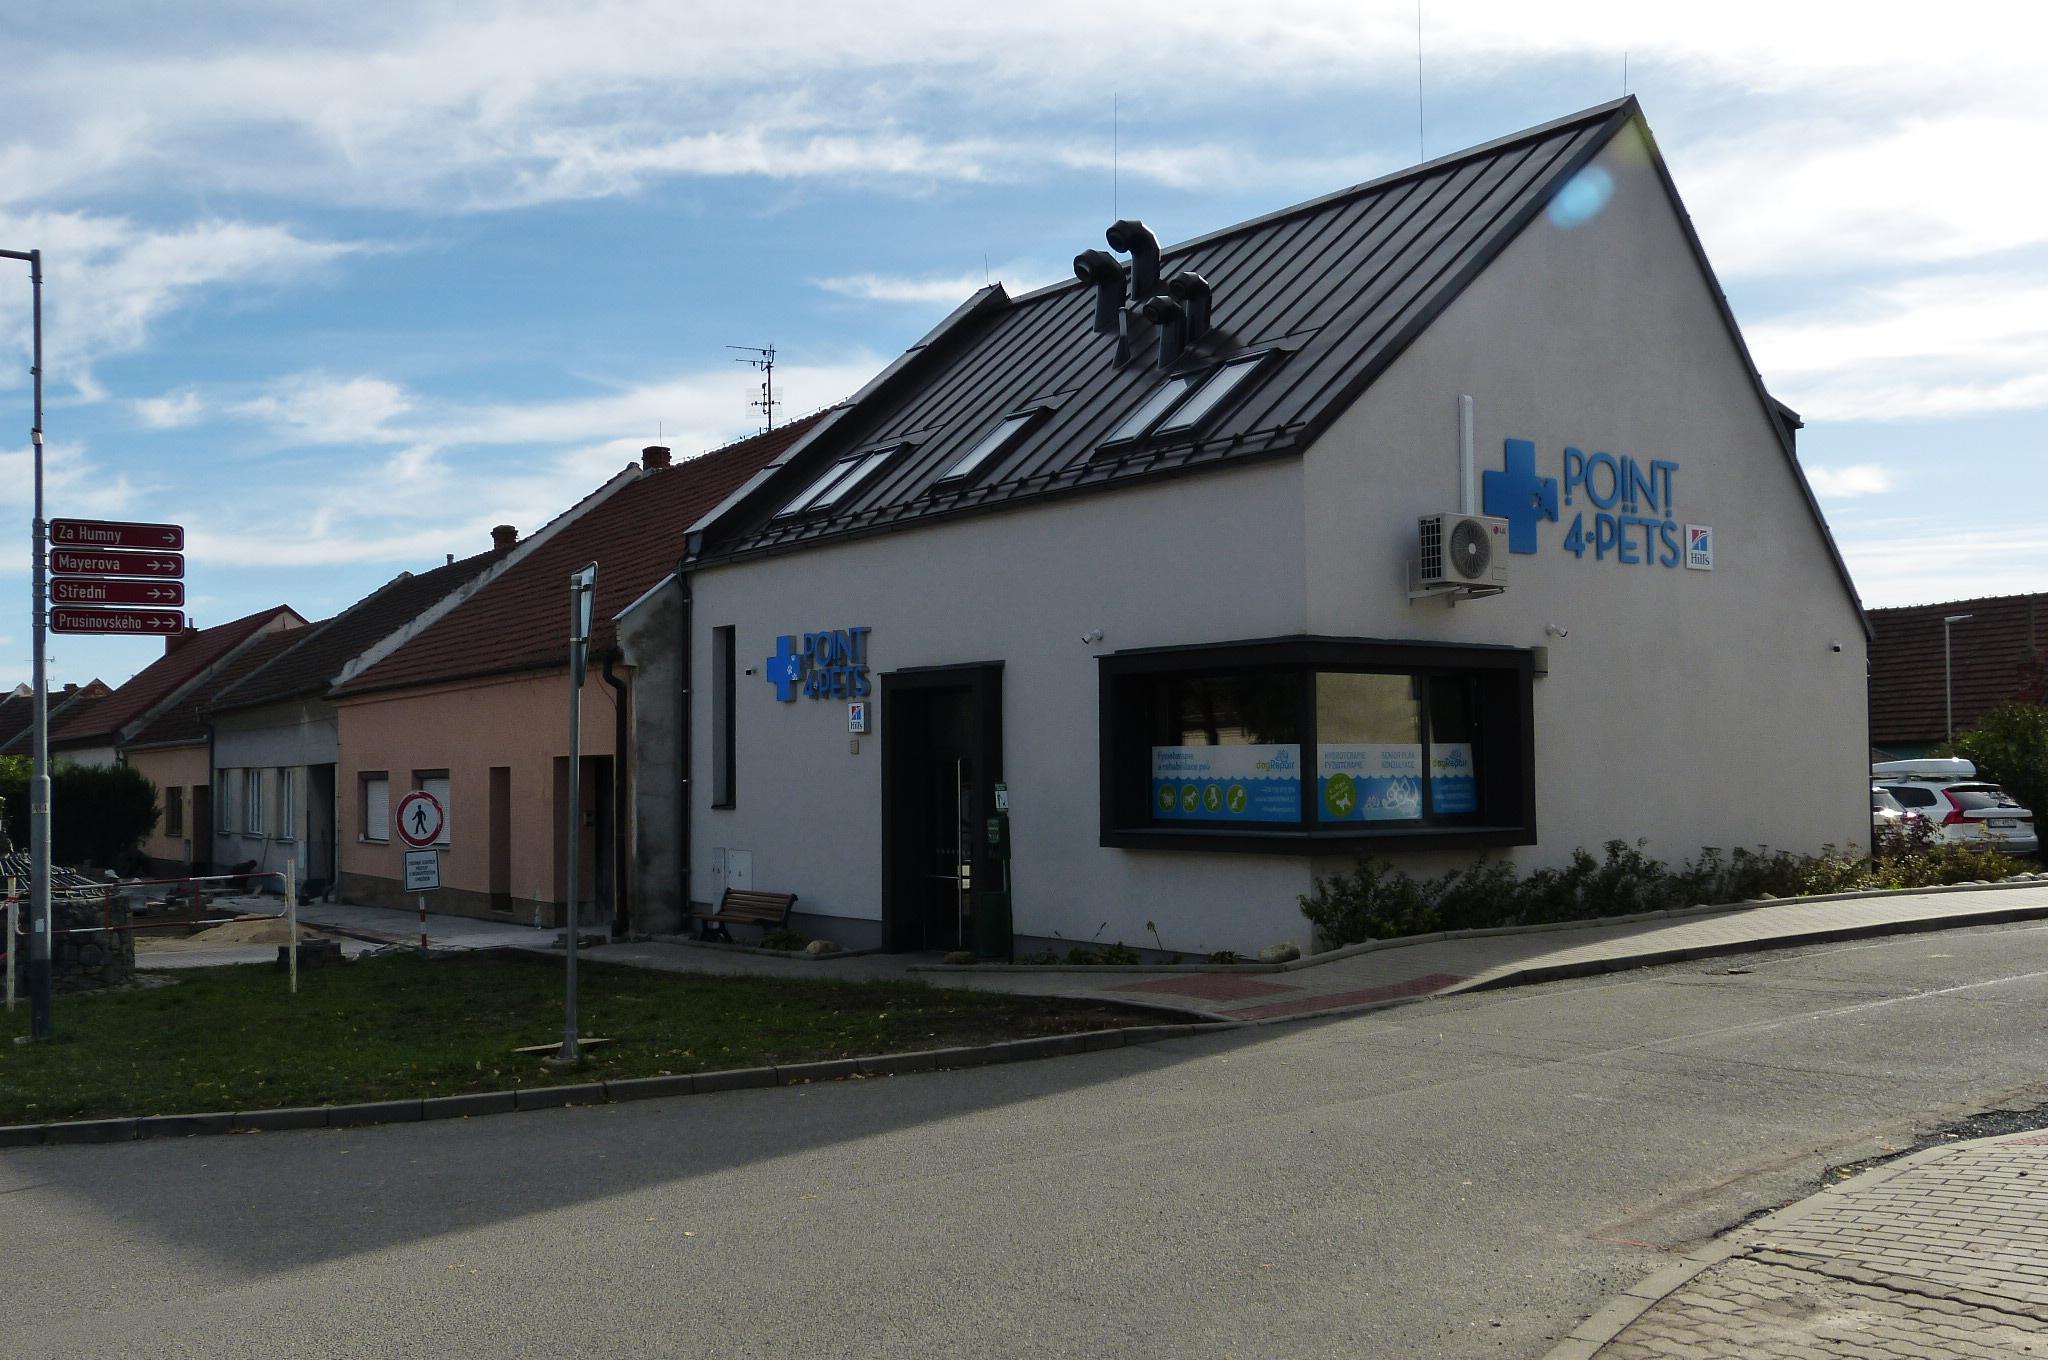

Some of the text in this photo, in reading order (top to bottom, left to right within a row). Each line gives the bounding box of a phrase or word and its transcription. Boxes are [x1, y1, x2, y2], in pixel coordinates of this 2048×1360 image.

[1563, 447, 1680, 517] POINT
[58, 525, 122, 544] Za Humny
[58, 554, 120, 572] Mayerova
[58, 584, 107, 599] Střední
[58, 613, 142, 630] Prusinovského
[803, 626, 872, 668] POINT
[1256, 759, 1295, 772] dogRepair
